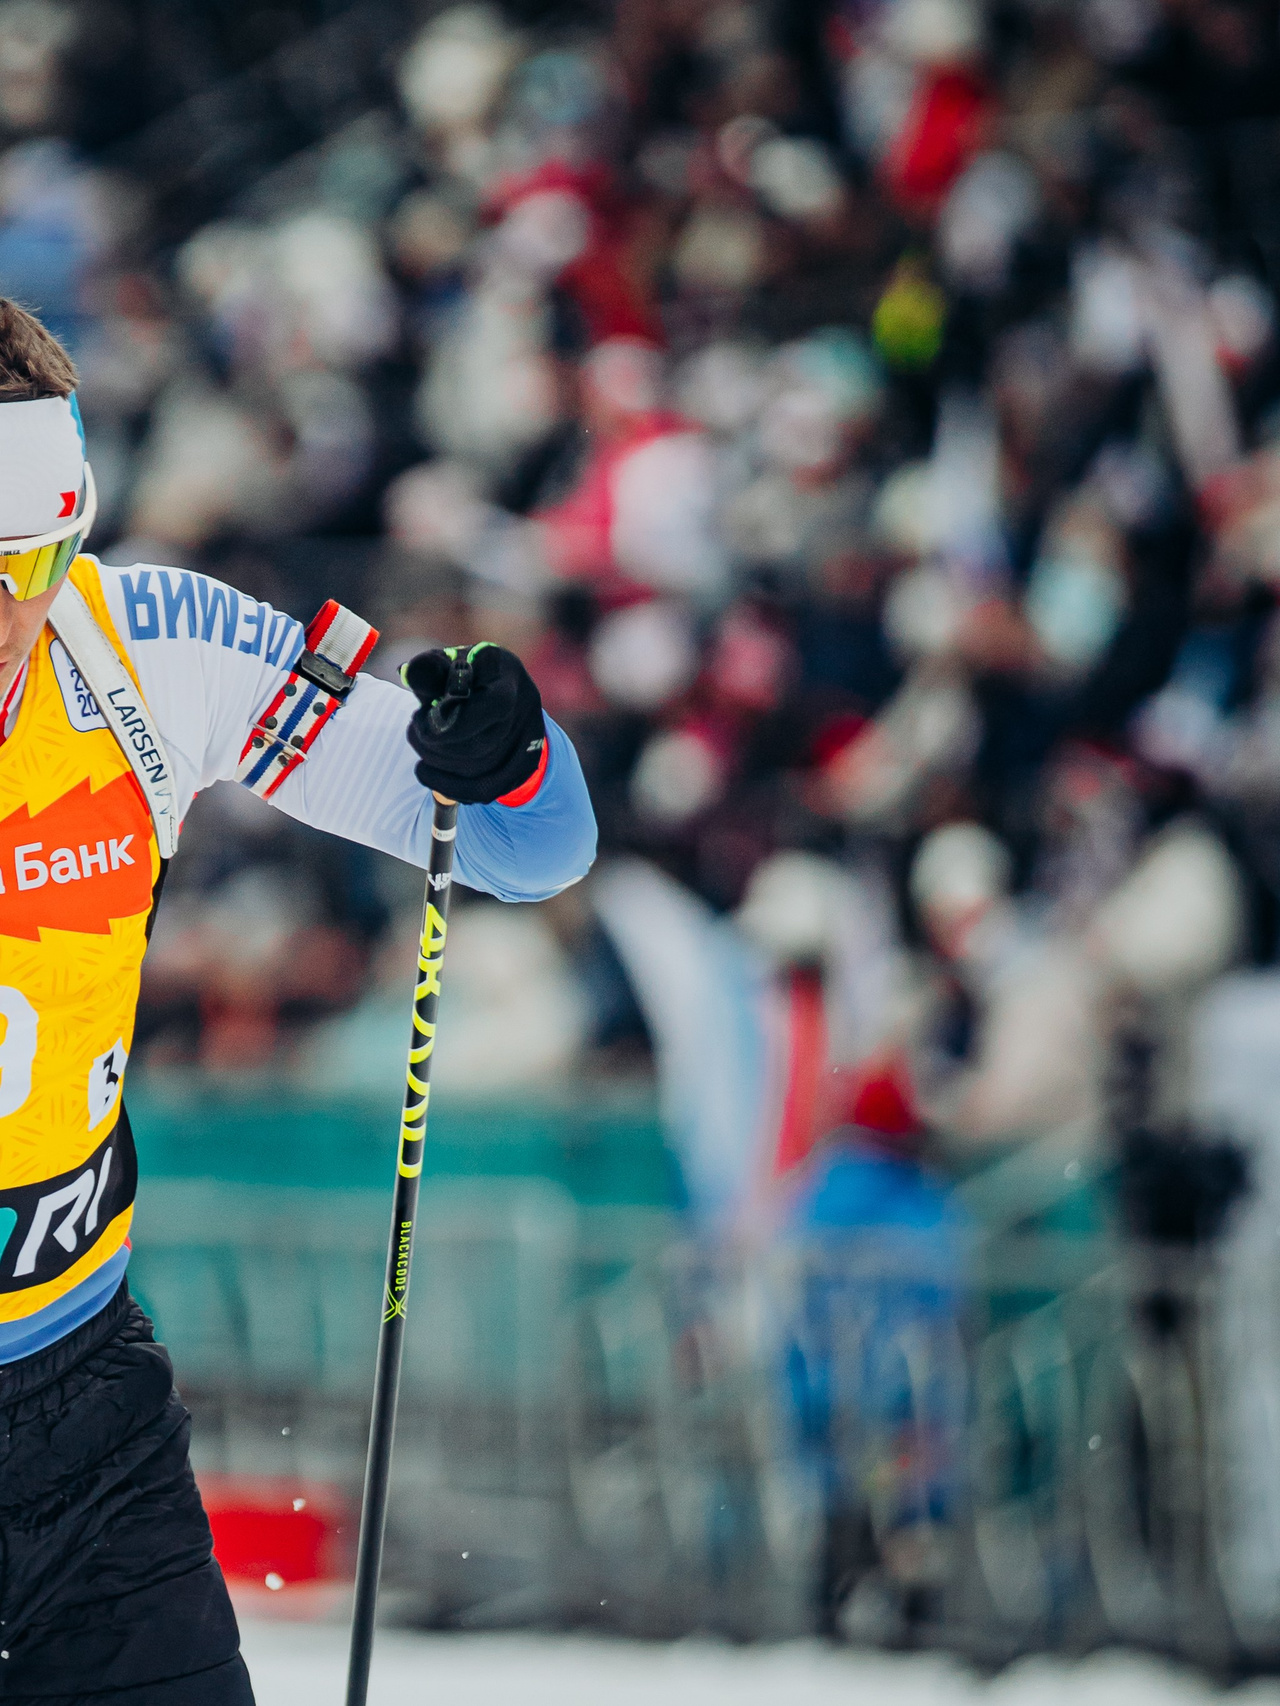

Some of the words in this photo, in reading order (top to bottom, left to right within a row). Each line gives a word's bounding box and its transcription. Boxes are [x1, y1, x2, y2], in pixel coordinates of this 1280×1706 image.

[106, 687, 169, 784] LARSEN
[14, 833, 136, 892] Банк
[394, 1220, 412, 1292] BLACKCODE
